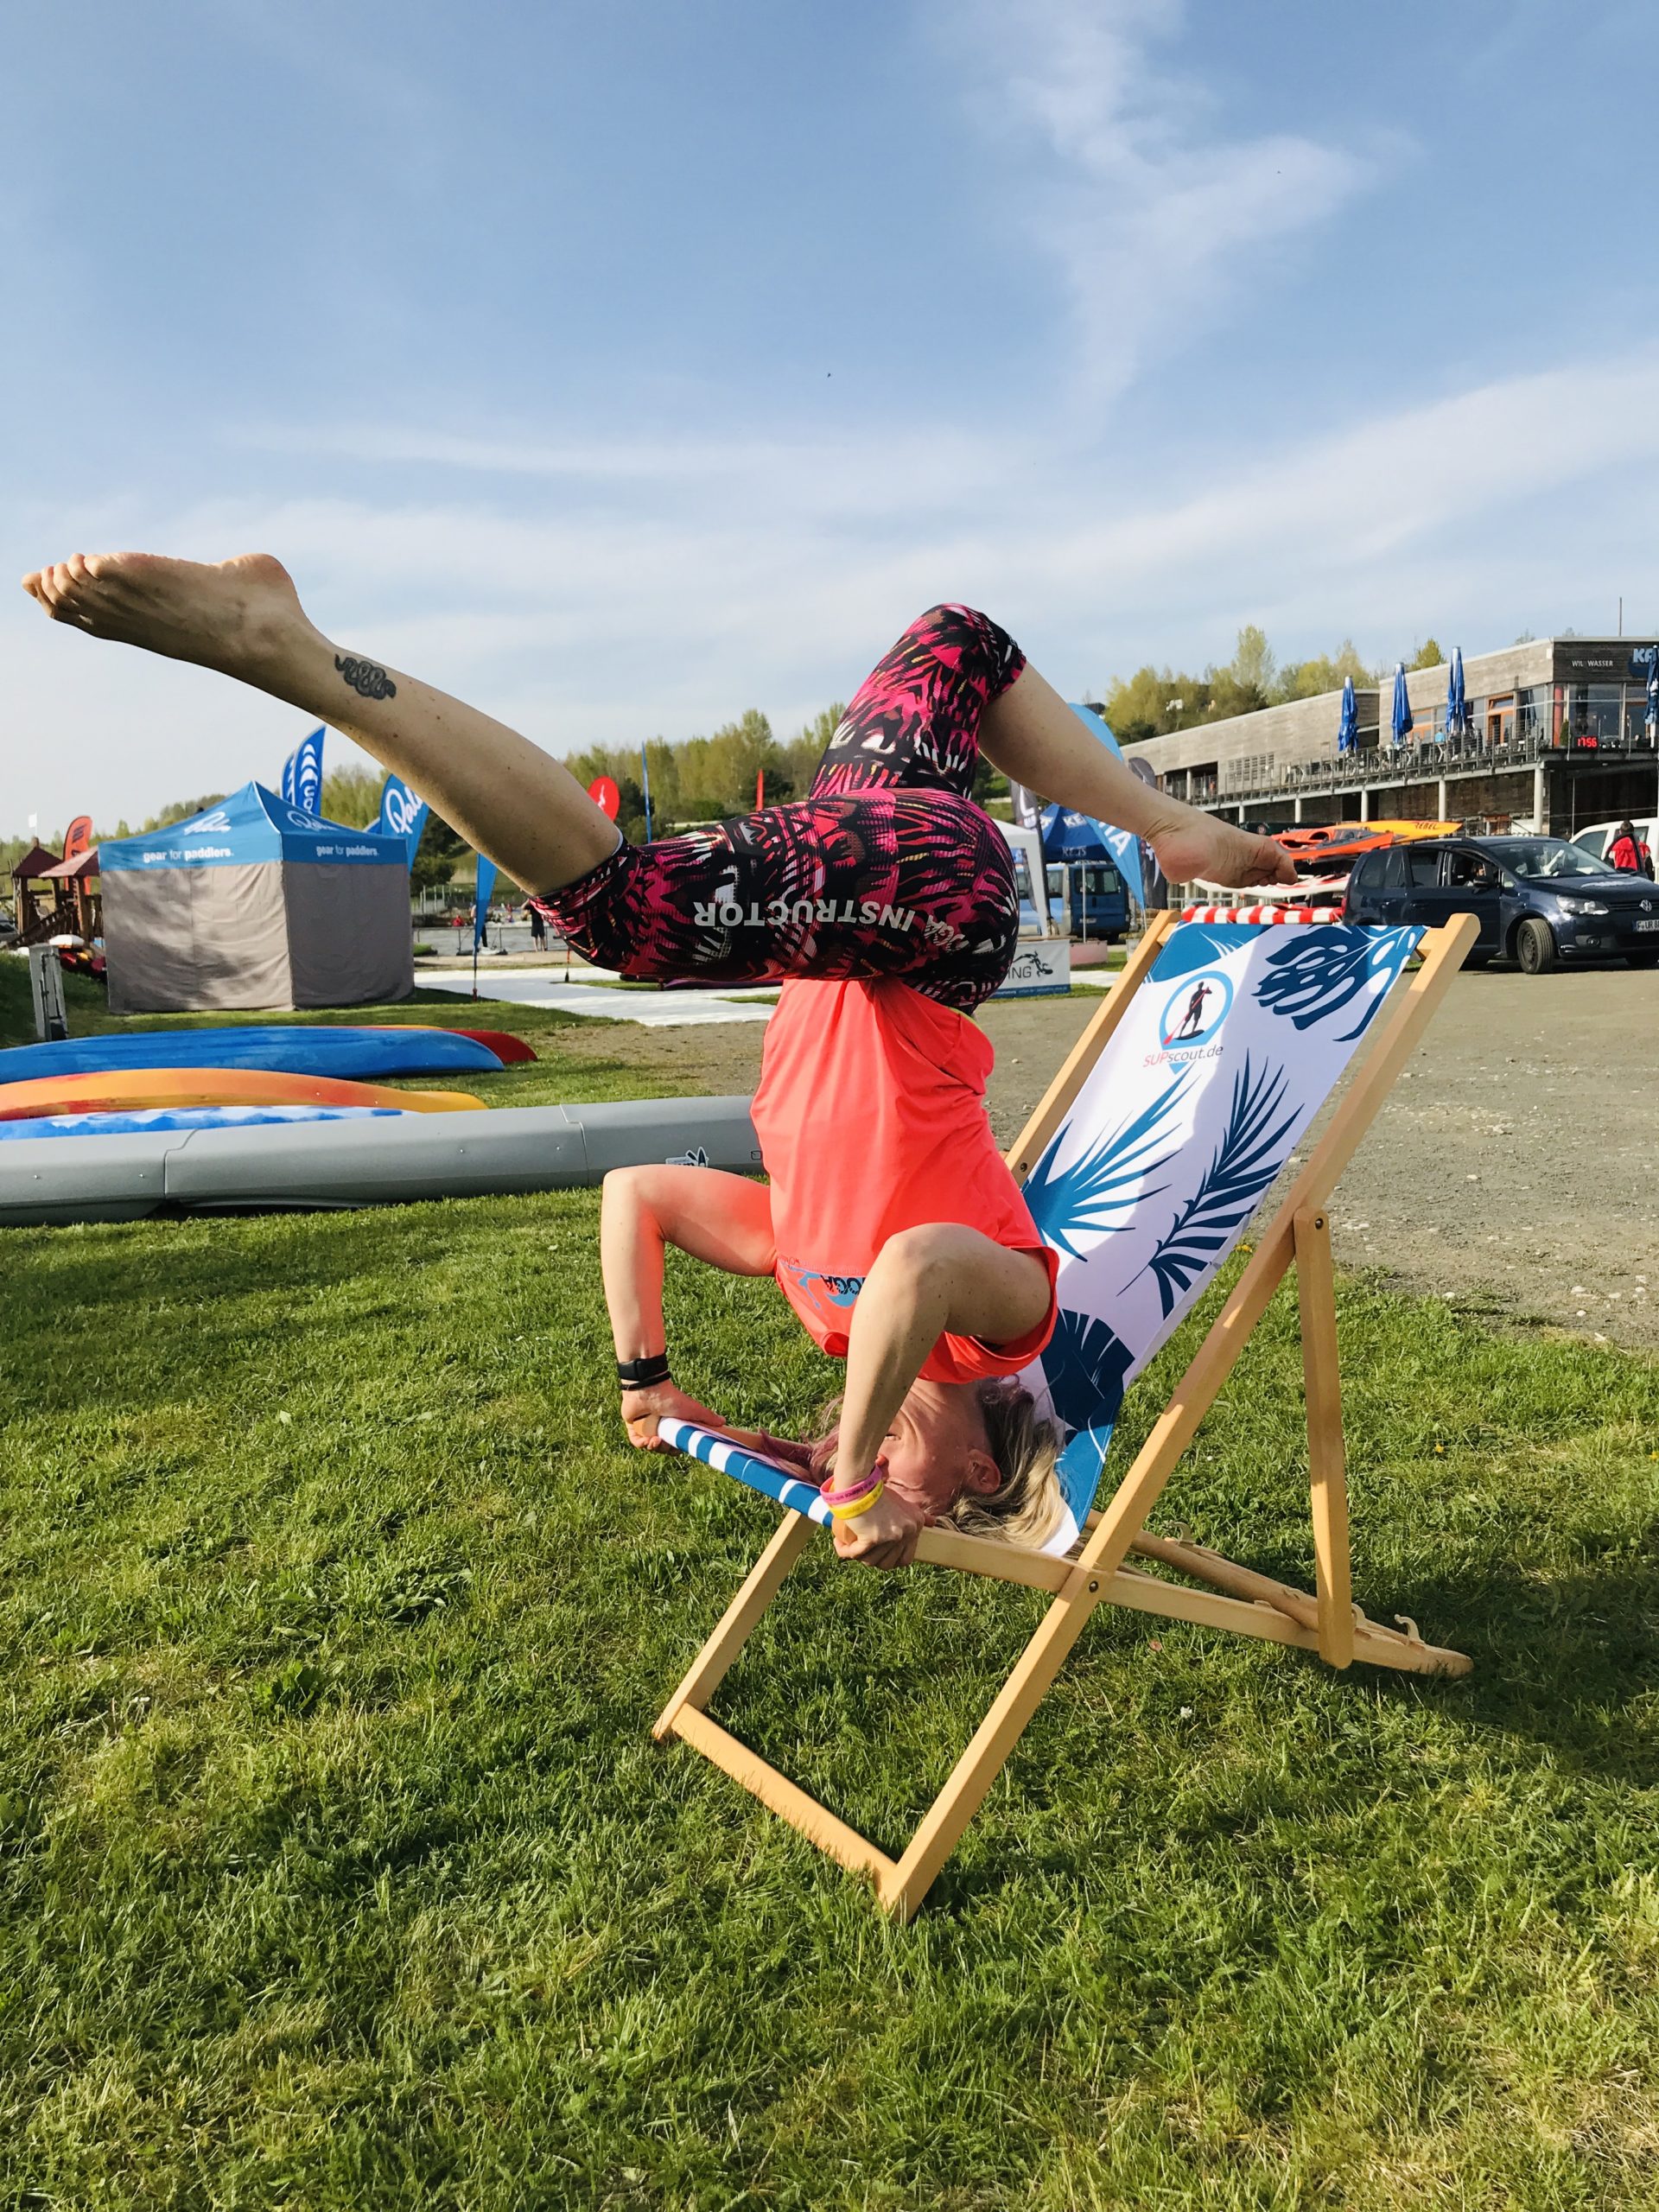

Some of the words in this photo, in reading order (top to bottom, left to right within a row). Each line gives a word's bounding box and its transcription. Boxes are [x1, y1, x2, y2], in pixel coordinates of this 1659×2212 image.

[1633, 648, 1657, 663] KA
[143, 850, 167, 863] gear
[169, 849, 182, 861] for
[315, 844, 334, 856] gear
[334, 843, 345, 855] for
[694, 899, 914, 931] INSTRUCTOR
[1007, 965, 1032, 980] ING
[1143, 1045, 1224, 1068] SUPscout.de
[820, 1274, 866, 1295] OGA
